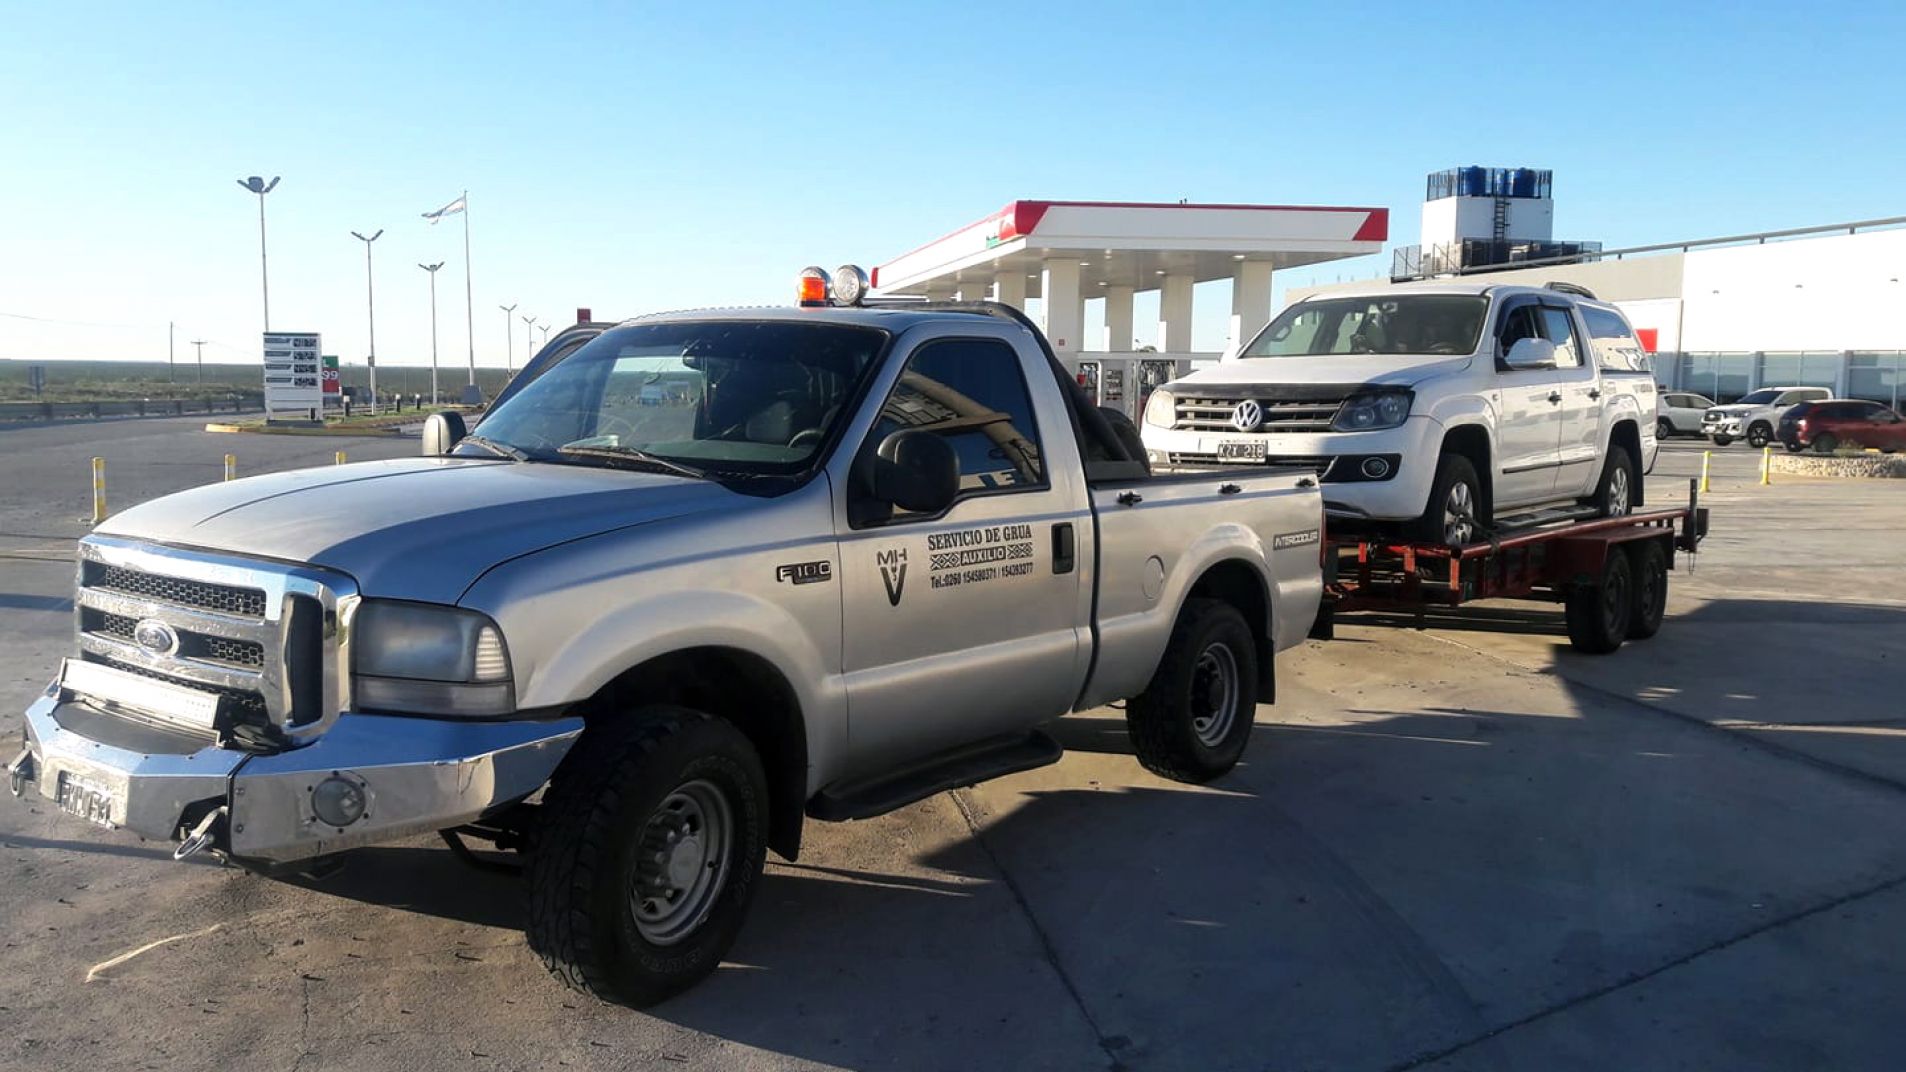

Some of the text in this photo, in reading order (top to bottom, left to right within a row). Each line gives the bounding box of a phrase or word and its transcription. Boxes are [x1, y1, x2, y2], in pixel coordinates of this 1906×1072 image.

[928, 524, 1032, 551] SERVICIO DE GRUA
[961, 546, 1006, 566] AUXILIO
